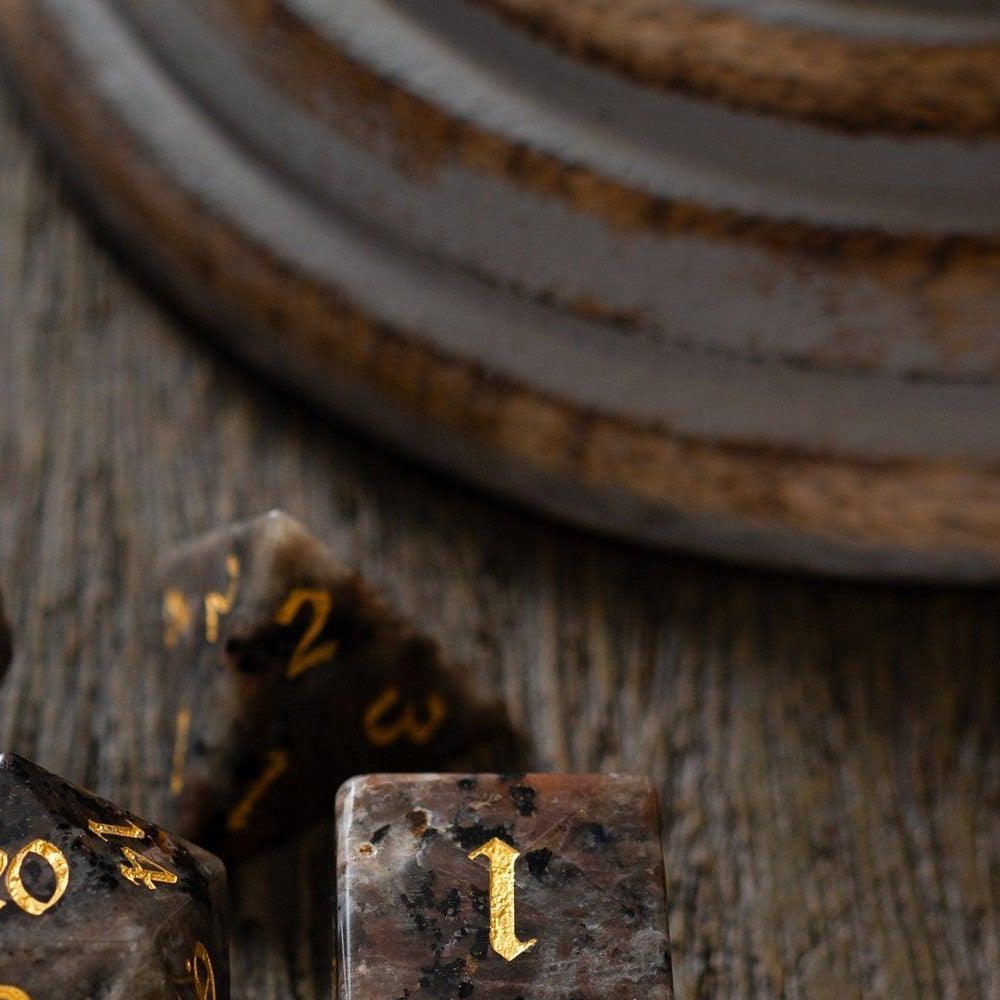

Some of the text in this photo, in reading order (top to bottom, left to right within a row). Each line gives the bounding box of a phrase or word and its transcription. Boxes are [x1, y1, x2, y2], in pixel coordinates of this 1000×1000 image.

[276, 588, 339, 681] 2
[363, 688, 447, 748] 3
[467, 837, 538, 962] 1
